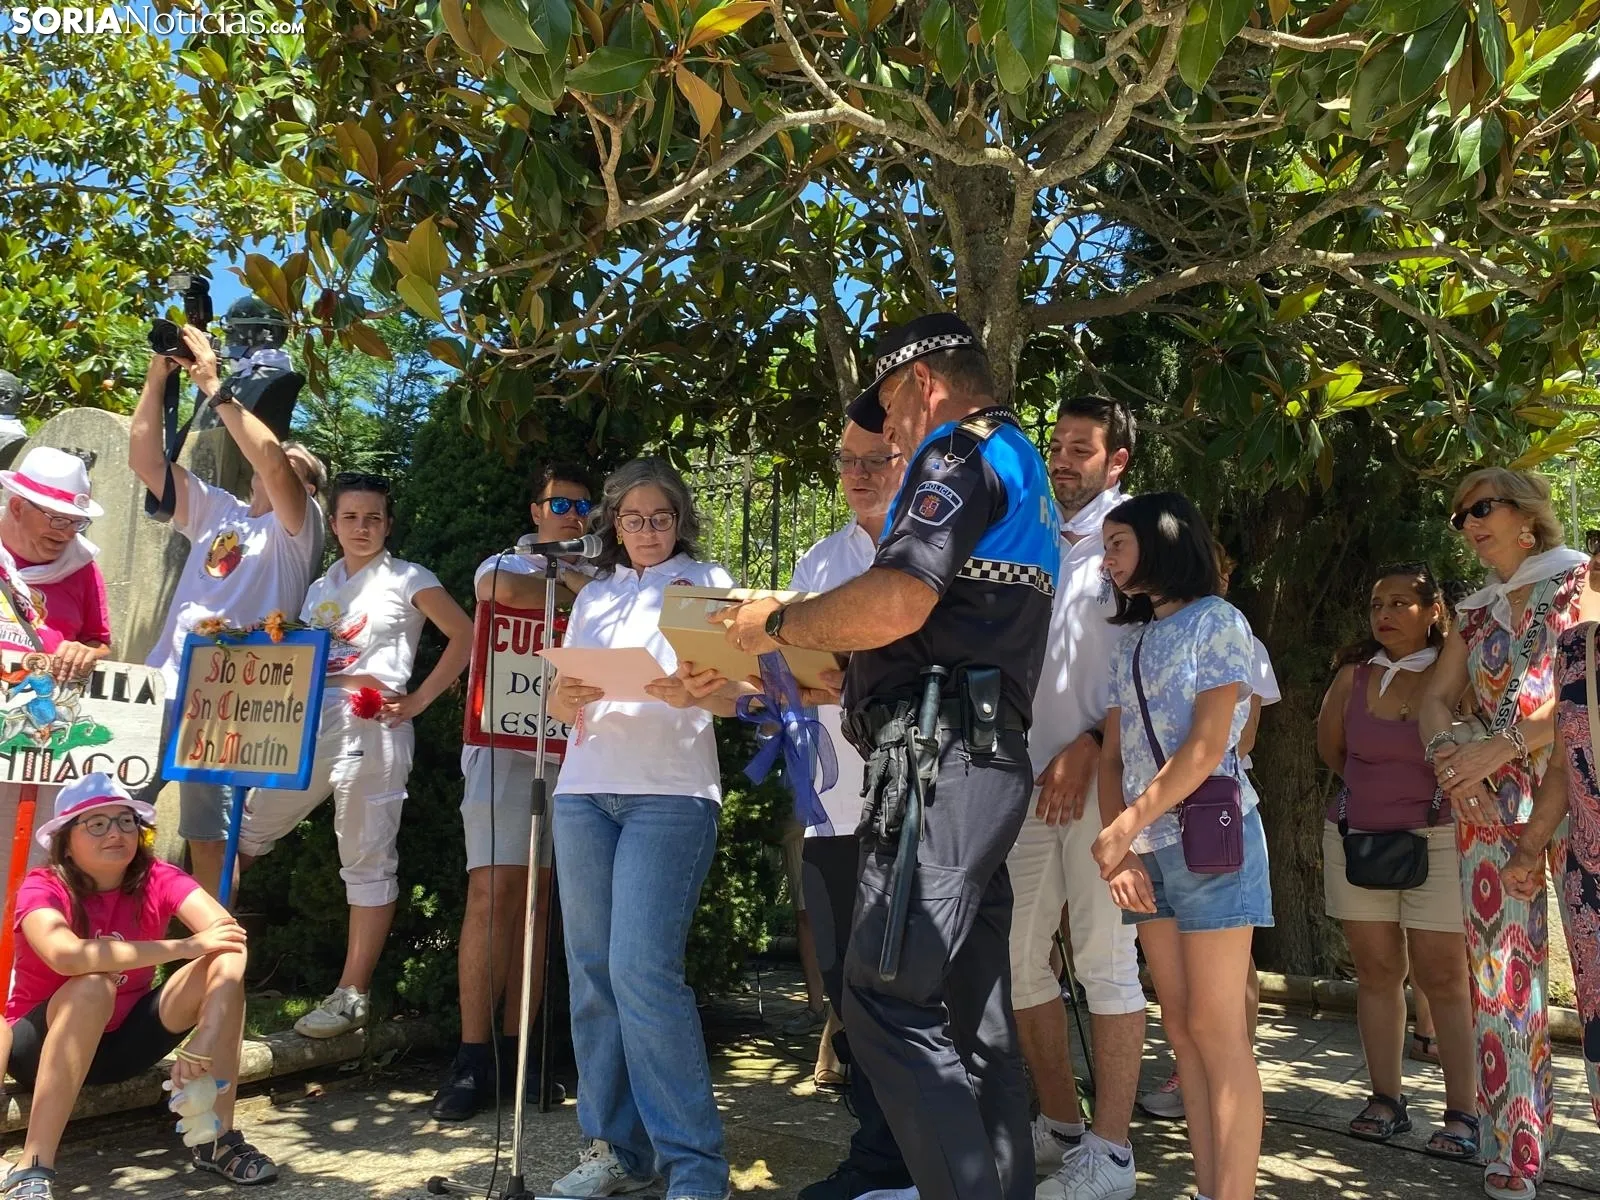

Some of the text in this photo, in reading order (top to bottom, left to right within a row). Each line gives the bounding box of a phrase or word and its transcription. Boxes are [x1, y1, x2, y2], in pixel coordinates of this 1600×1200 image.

[1520, 602, 1549, 658] CLASSY
[243, 651, 294, 685] Tomé
[217, 690, 304, 723] Clemente
